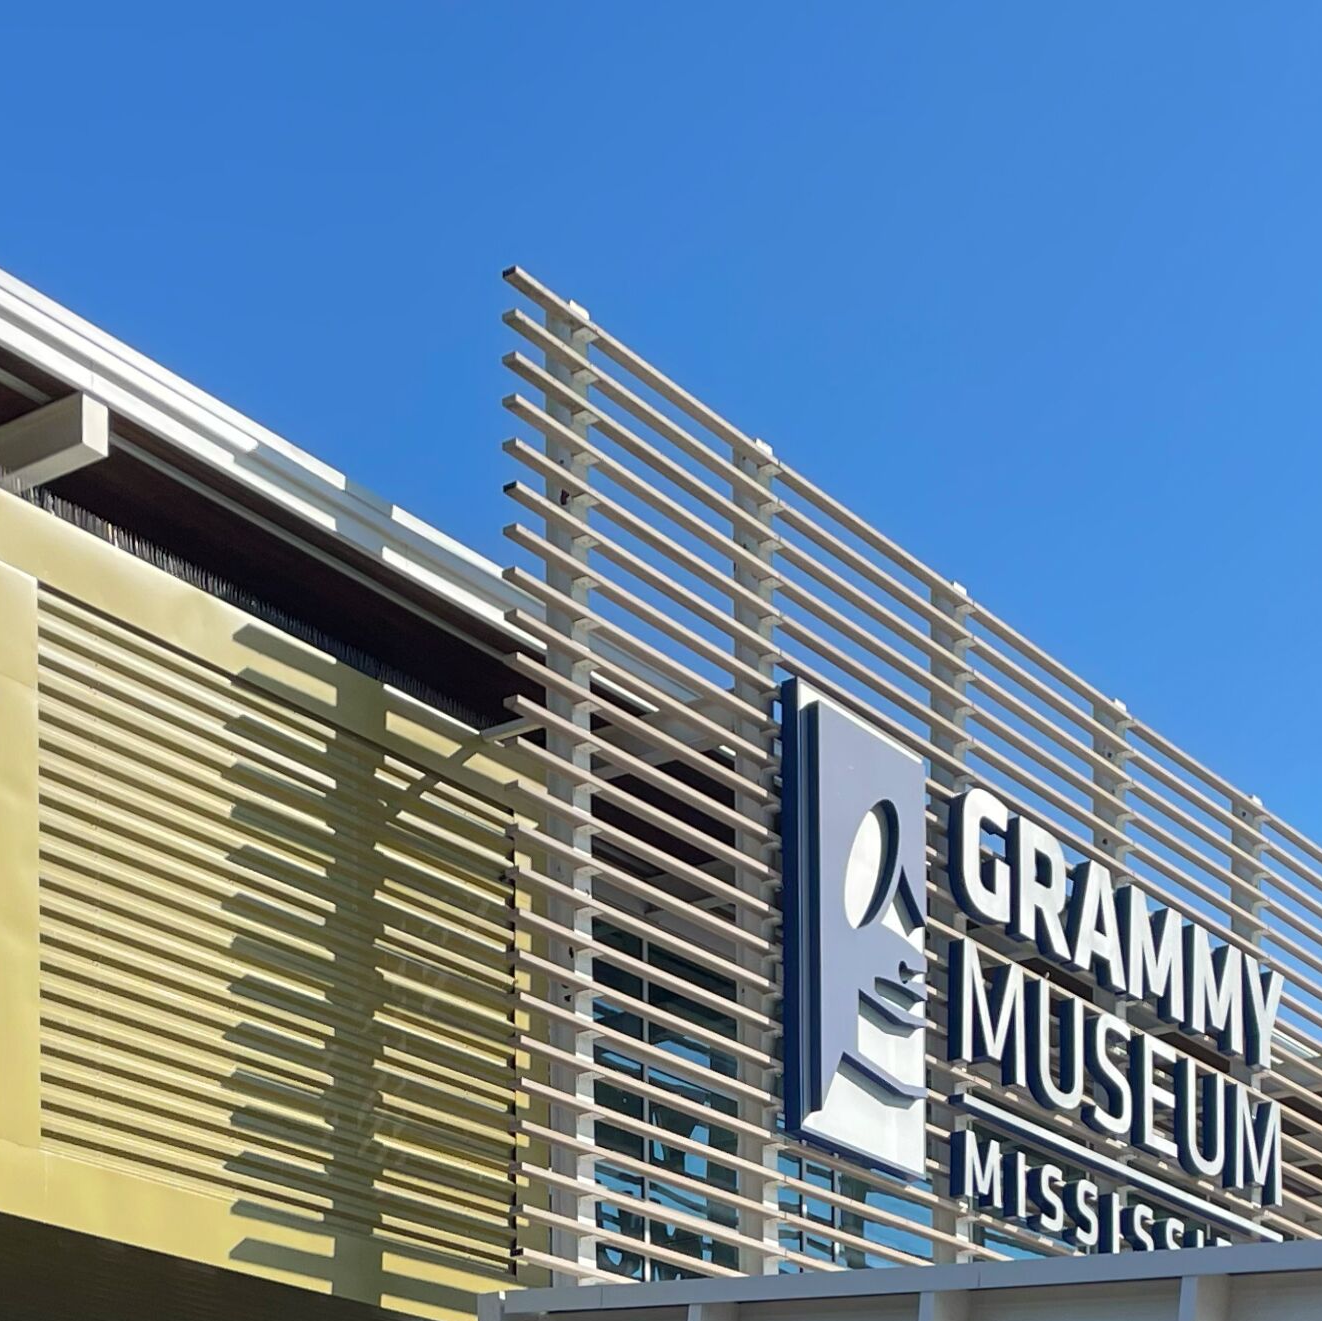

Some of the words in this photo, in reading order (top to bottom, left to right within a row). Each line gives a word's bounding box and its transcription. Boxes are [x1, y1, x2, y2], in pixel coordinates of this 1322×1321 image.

[953, 787, 1284, 1070] GRAMMY
[952, 937, 1283, 1207] MUSEUM
[953, 1129, 1232, 1254] MISSISS
